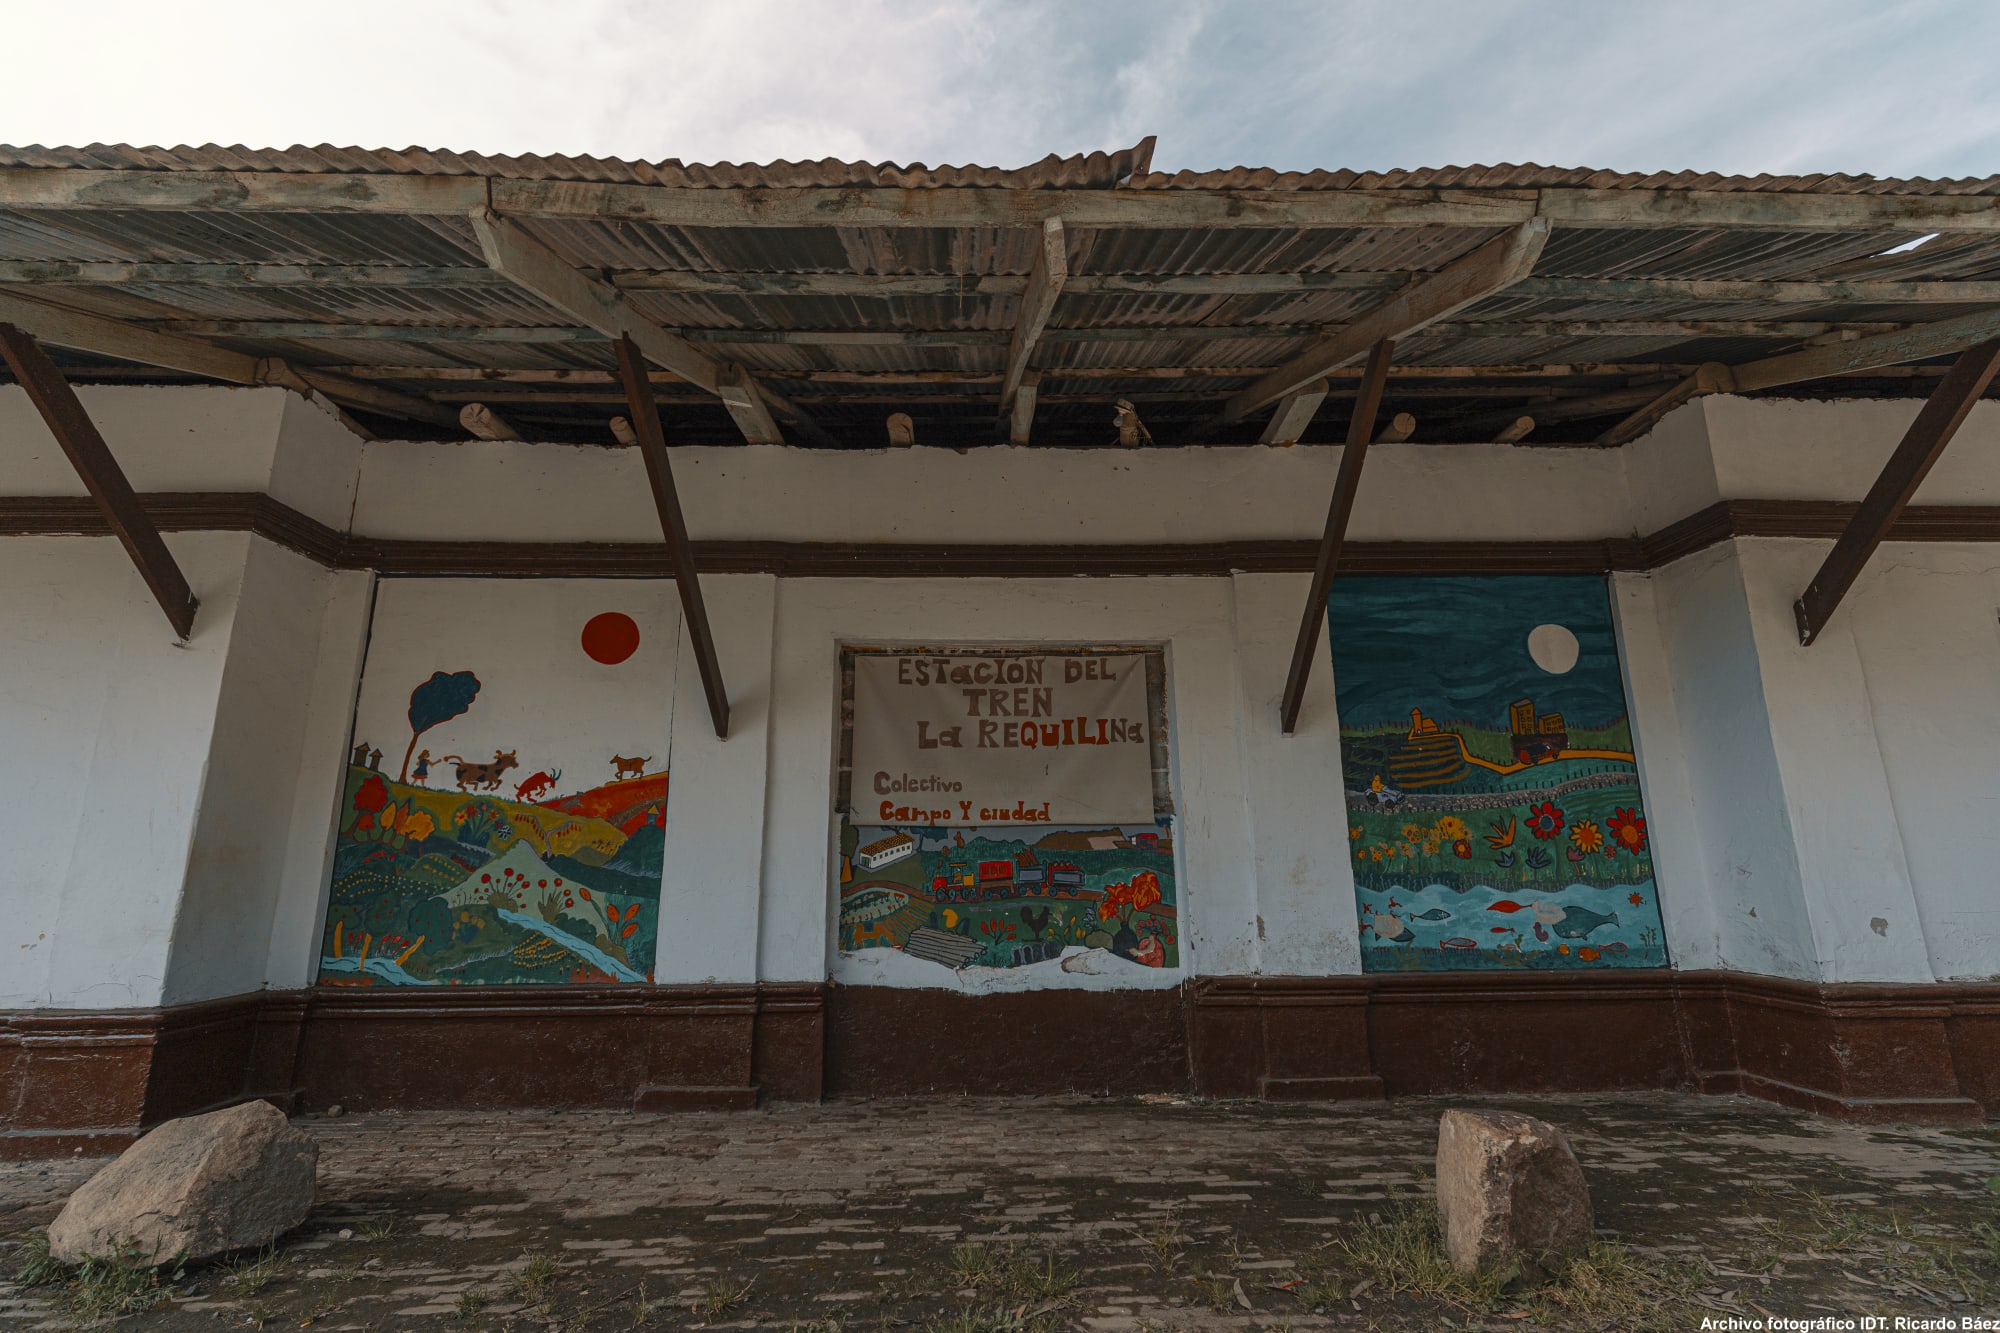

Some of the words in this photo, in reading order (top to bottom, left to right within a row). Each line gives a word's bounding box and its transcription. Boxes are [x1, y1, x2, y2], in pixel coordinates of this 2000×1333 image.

[1064, 658, 1117, 684] DEL
[962, 687, 1054, 718] TREN
[917, 721, 963, 749] La
[873, 771, 963, 795] Colectivo
[879, 800, 951, 826] Campo
[979, 800, 1051, 822] ciudad
